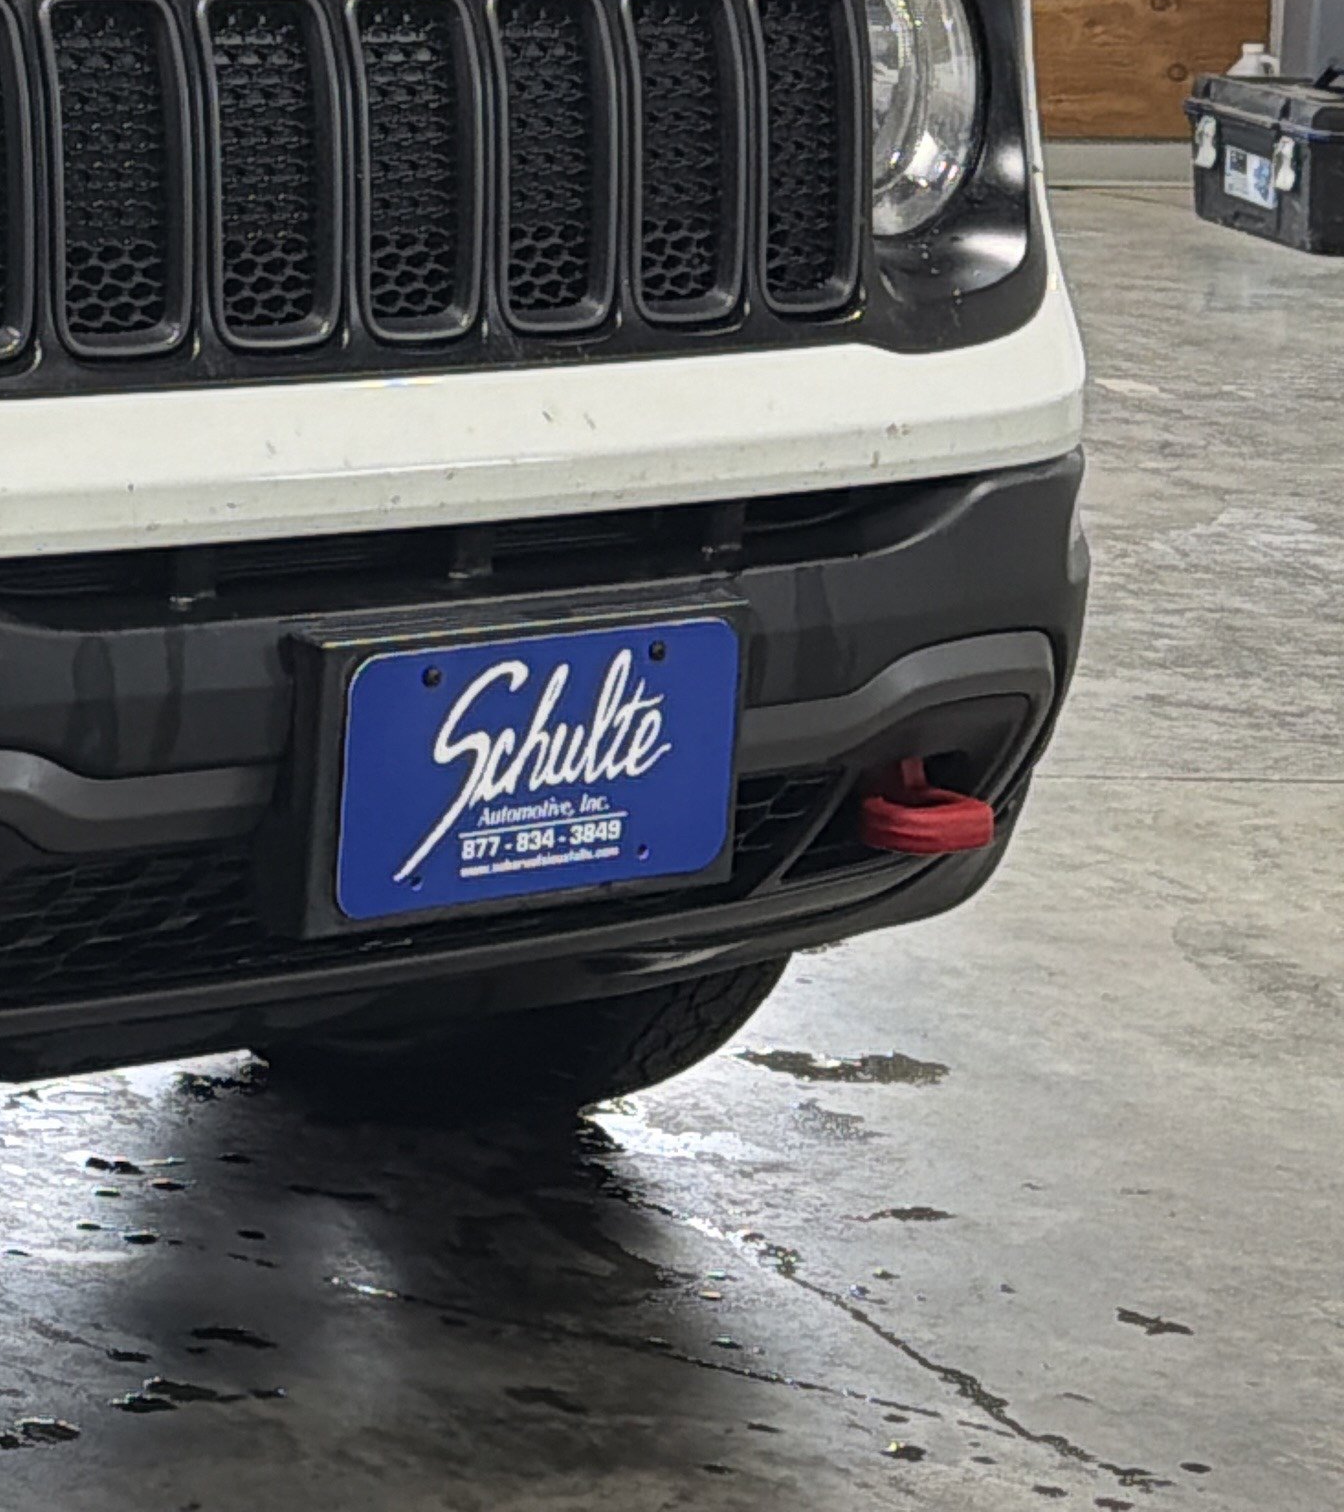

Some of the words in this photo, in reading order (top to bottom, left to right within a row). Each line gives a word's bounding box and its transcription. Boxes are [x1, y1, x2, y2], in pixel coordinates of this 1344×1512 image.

[393, 648, 672, 882] Schulte
[580, 792, 611, 814] Inc.
[461, 835, 501, 861] 877
[516, 828, 555, 853] 834
[569, 819, 622, 845] 3849
